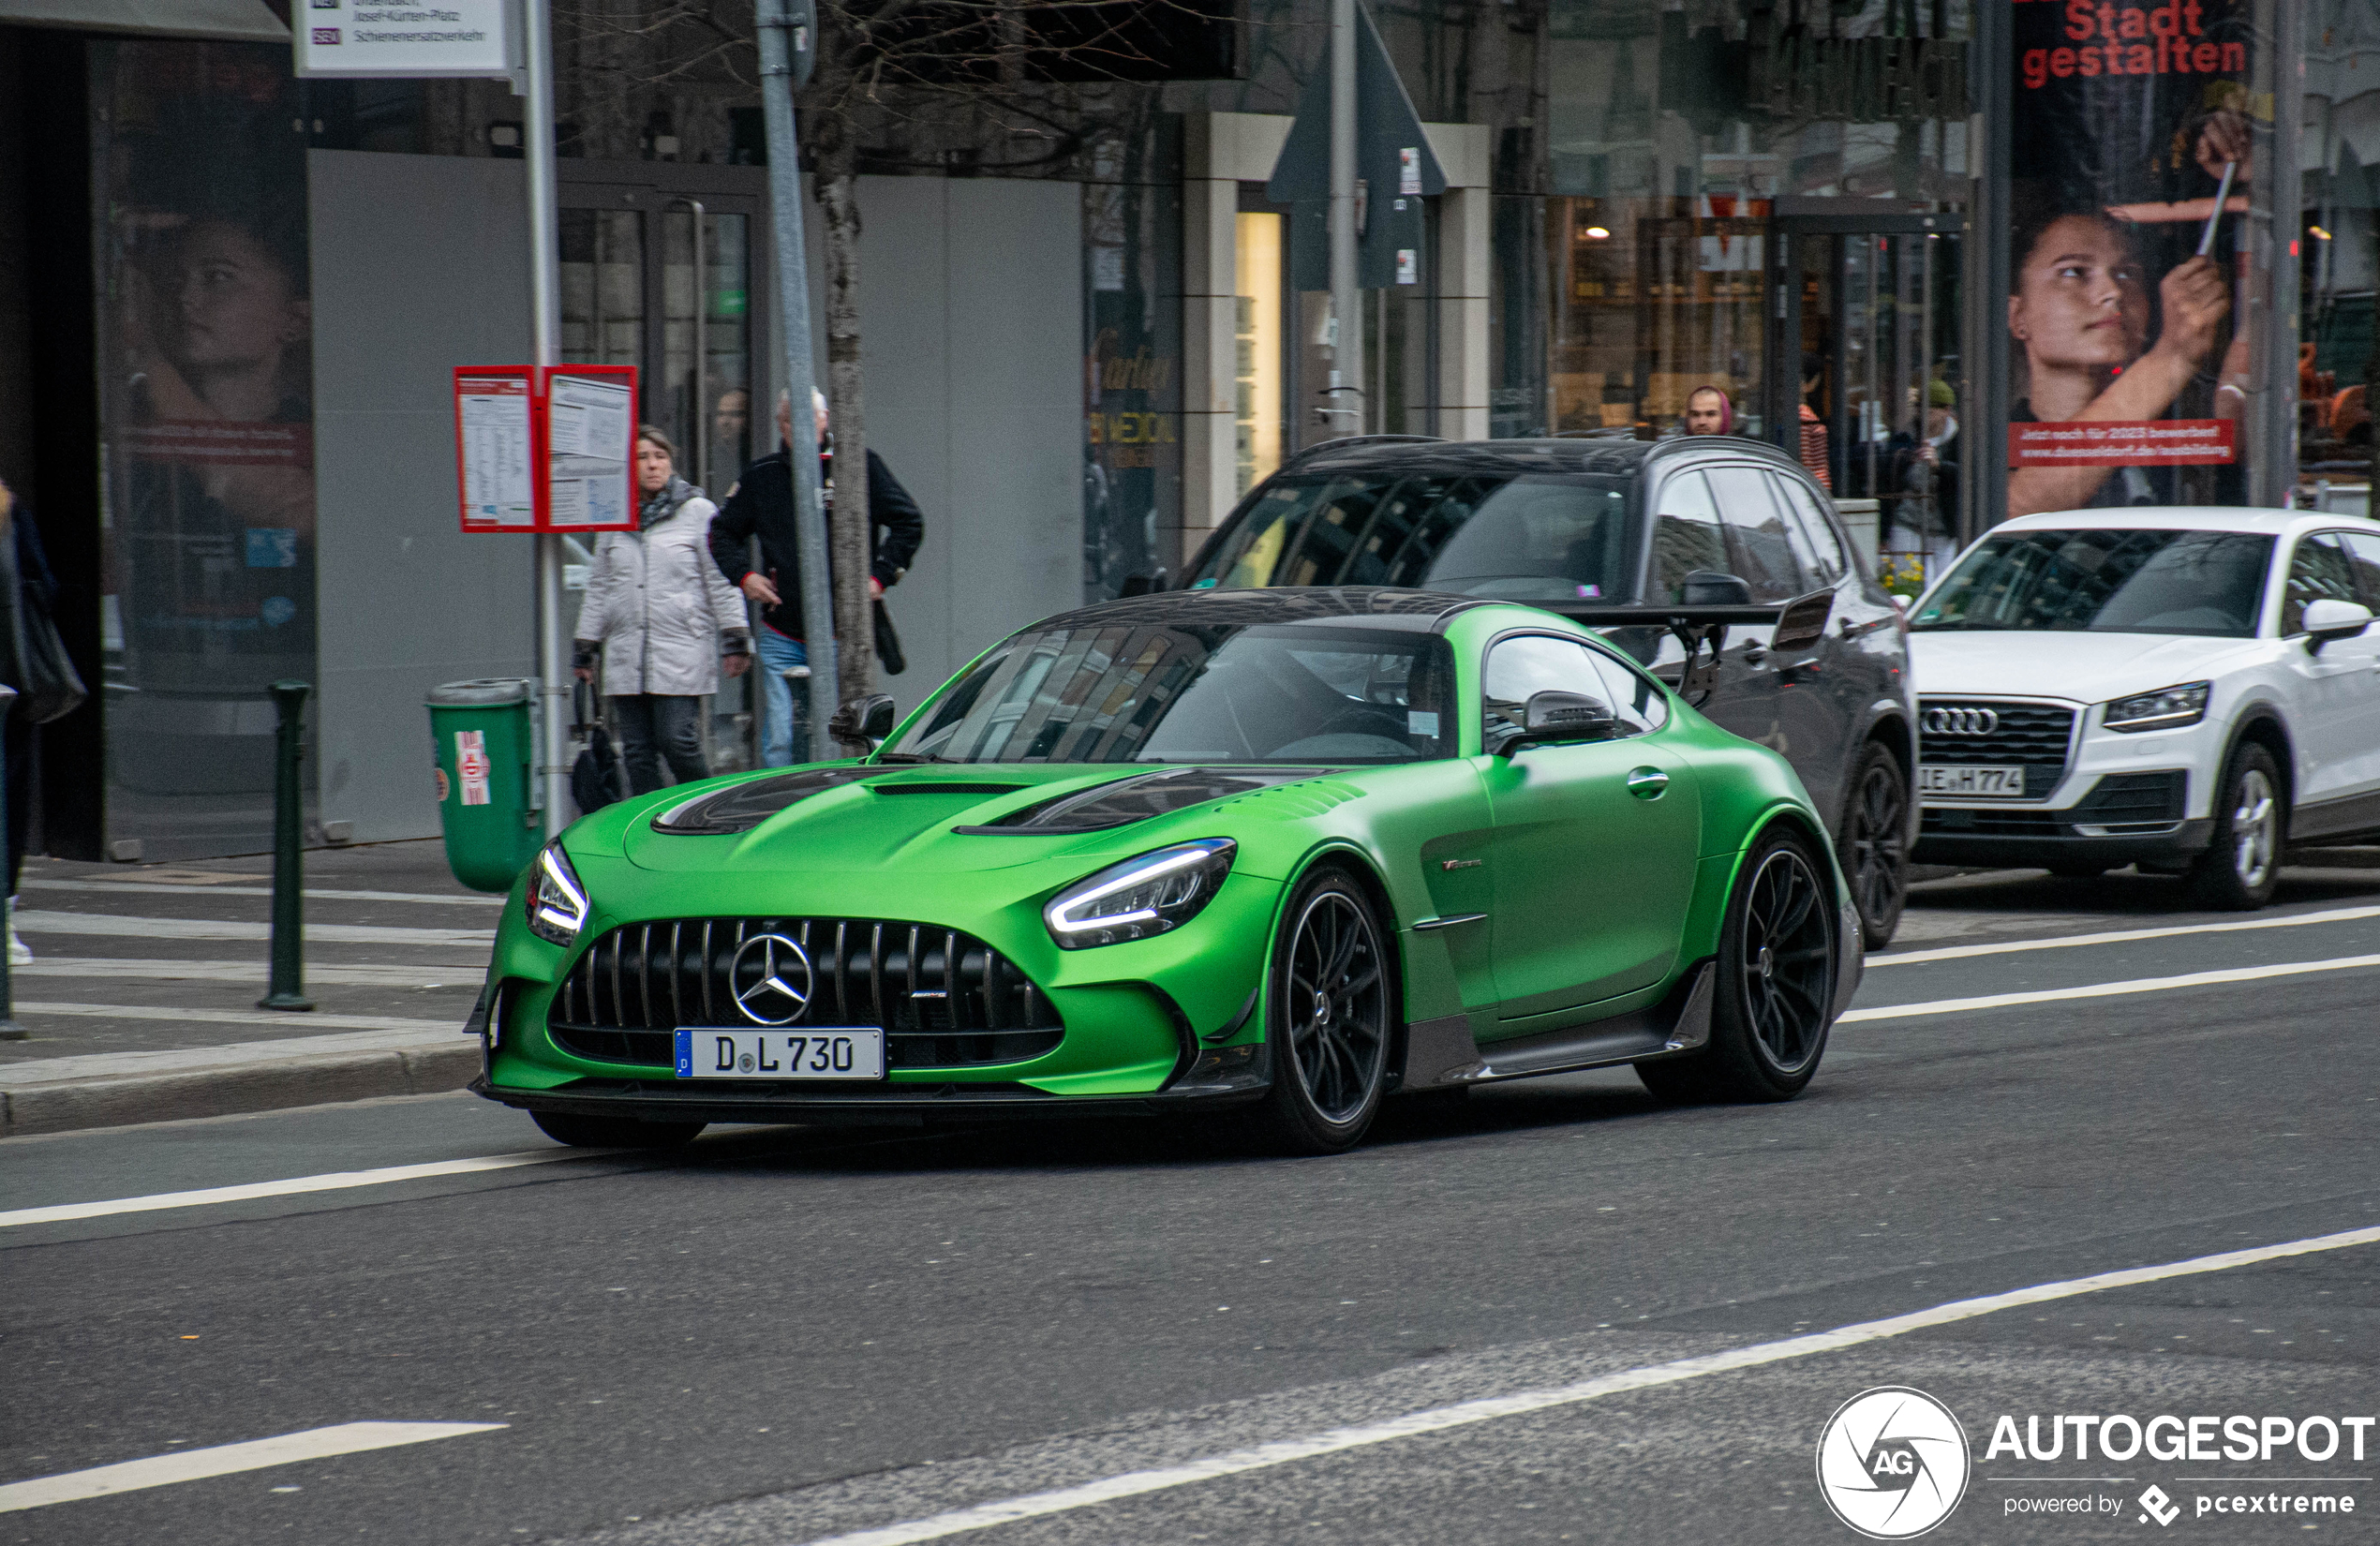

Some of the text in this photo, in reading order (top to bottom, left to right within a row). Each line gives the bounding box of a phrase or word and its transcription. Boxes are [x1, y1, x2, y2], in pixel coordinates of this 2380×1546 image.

[2064, 0, 2202, 40] Stadt
[2022, 29, 2246, 89] gestalten
[680, 1059, 688, 1069] D
[716, 1036, 854, 1071] D L 730
